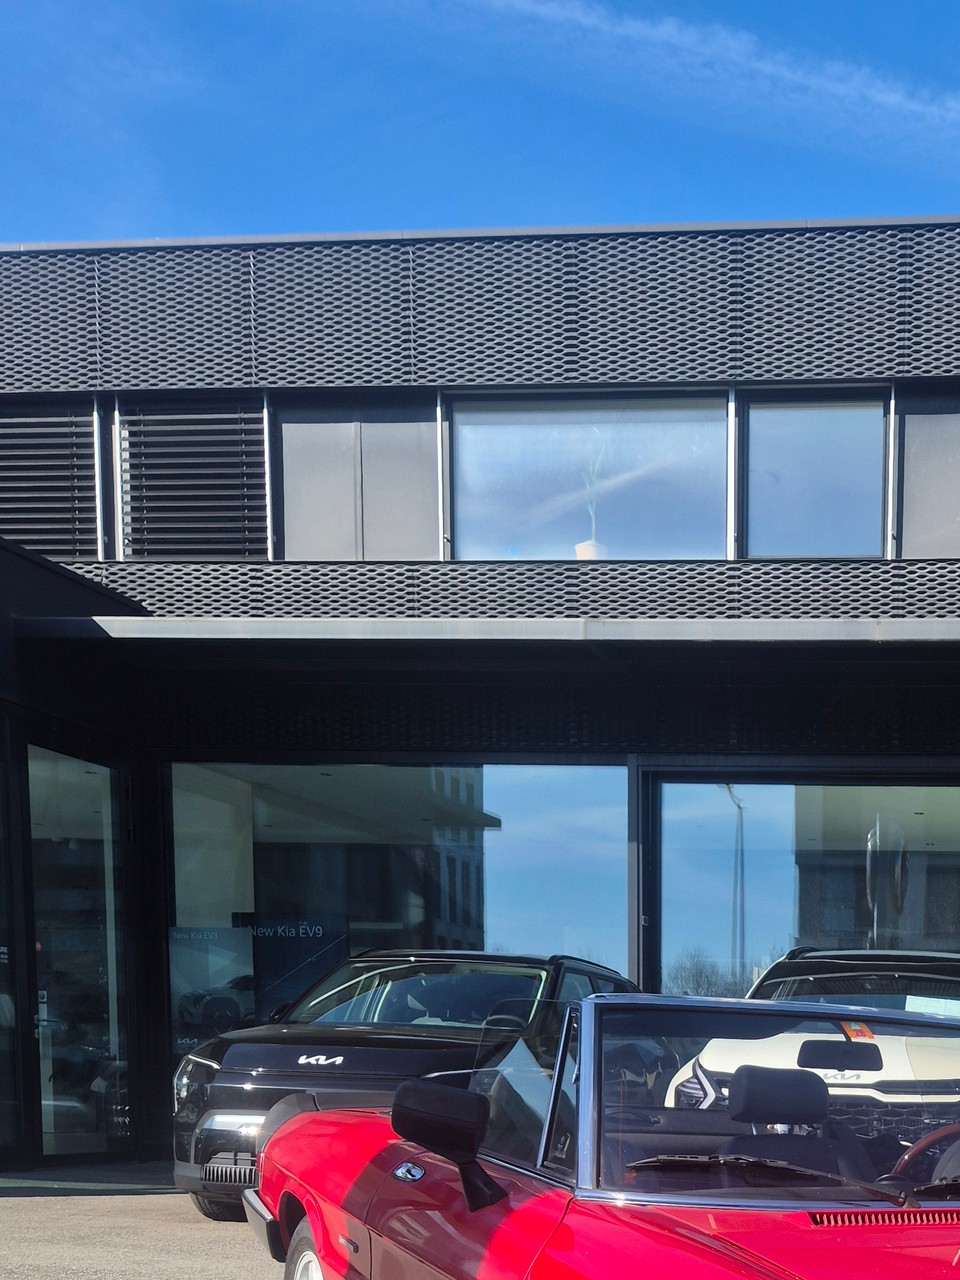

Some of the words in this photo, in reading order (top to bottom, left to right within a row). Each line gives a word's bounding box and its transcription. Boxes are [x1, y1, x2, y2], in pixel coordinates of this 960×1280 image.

[248, 925, 274, 937] New
[278, 925, 296, 937] Kia
[300, 925, 323, 938] EV9
